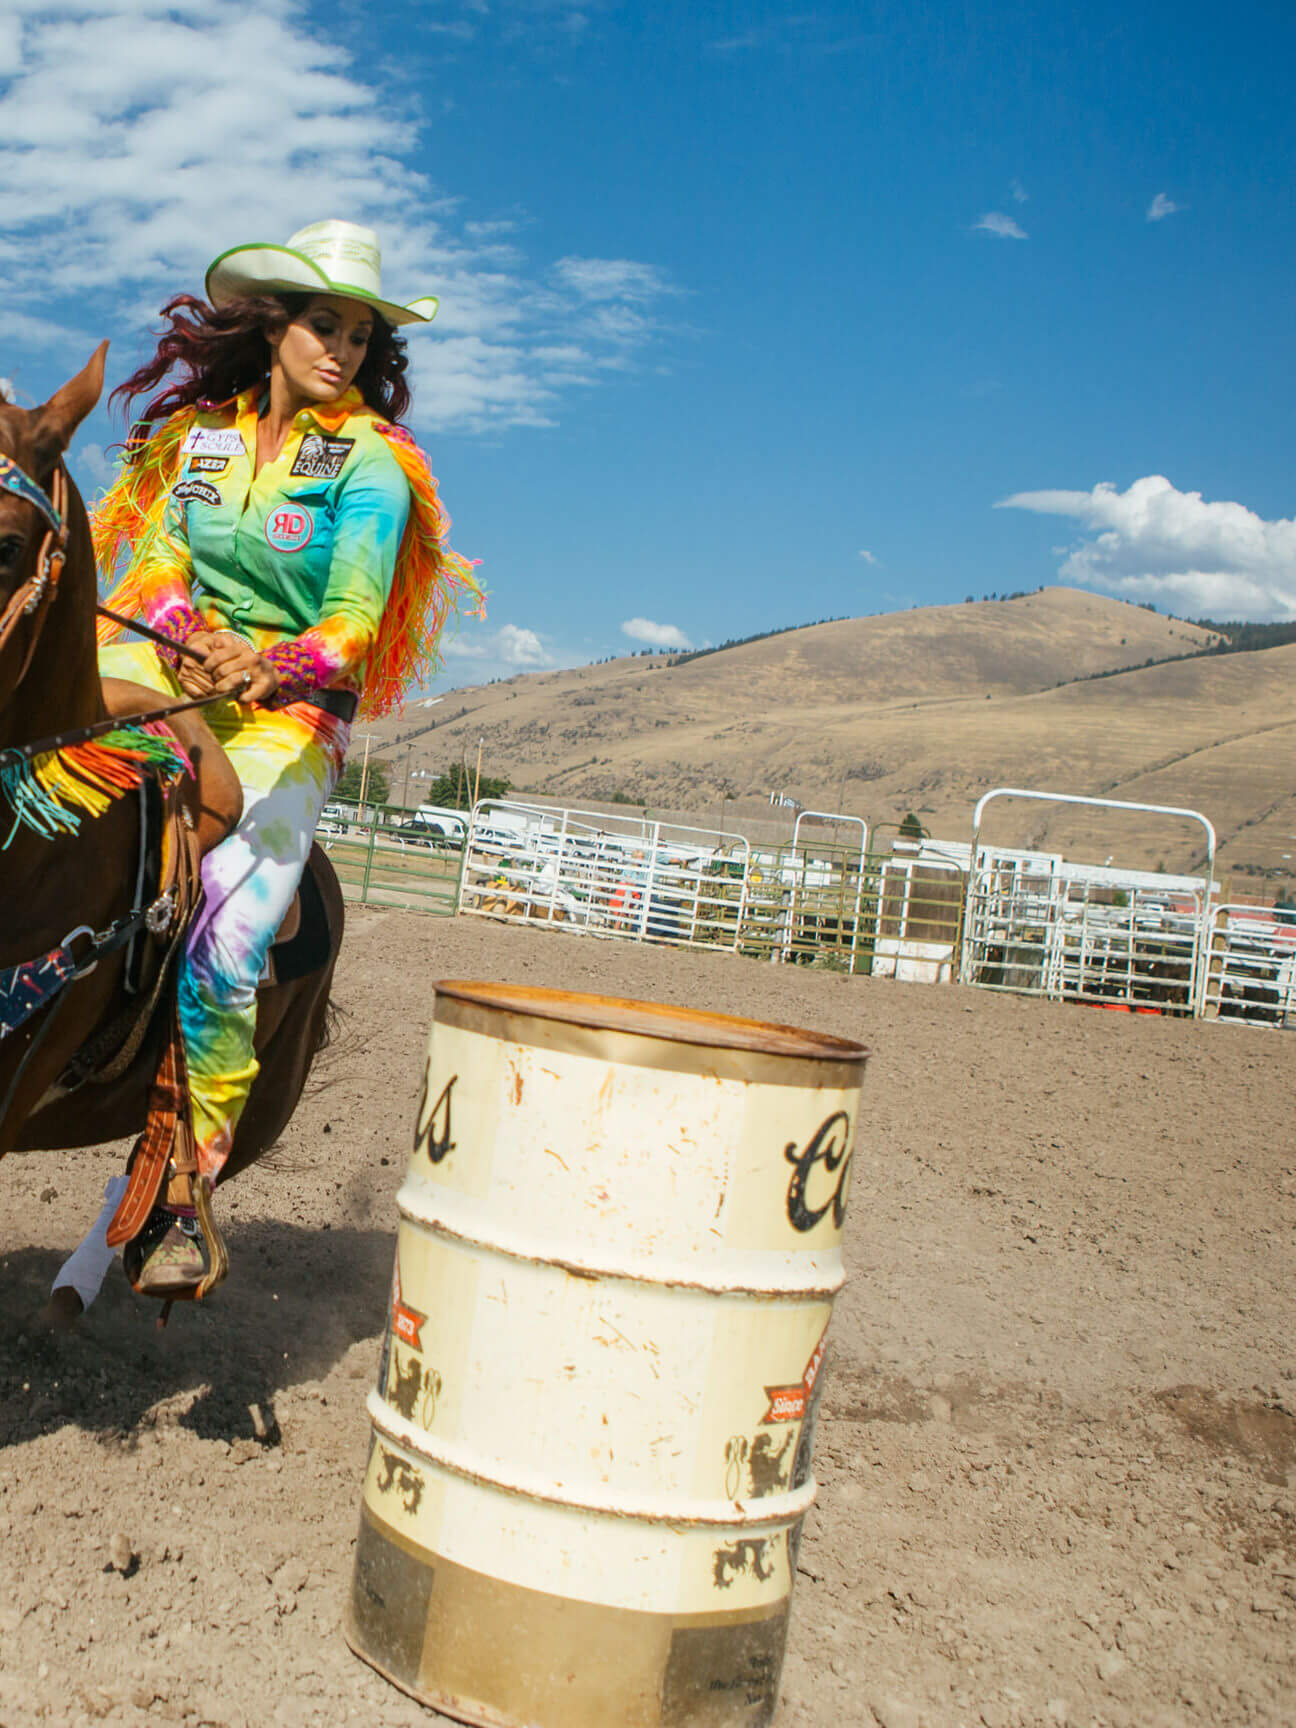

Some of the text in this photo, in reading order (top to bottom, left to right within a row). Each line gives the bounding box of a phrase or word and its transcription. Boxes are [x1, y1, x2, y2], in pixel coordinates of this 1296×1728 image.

[206, 432, 240, 442] GYPS
[292, 461, 343, 477] EQUINE
[772, 1397, 804, 1414] Since
